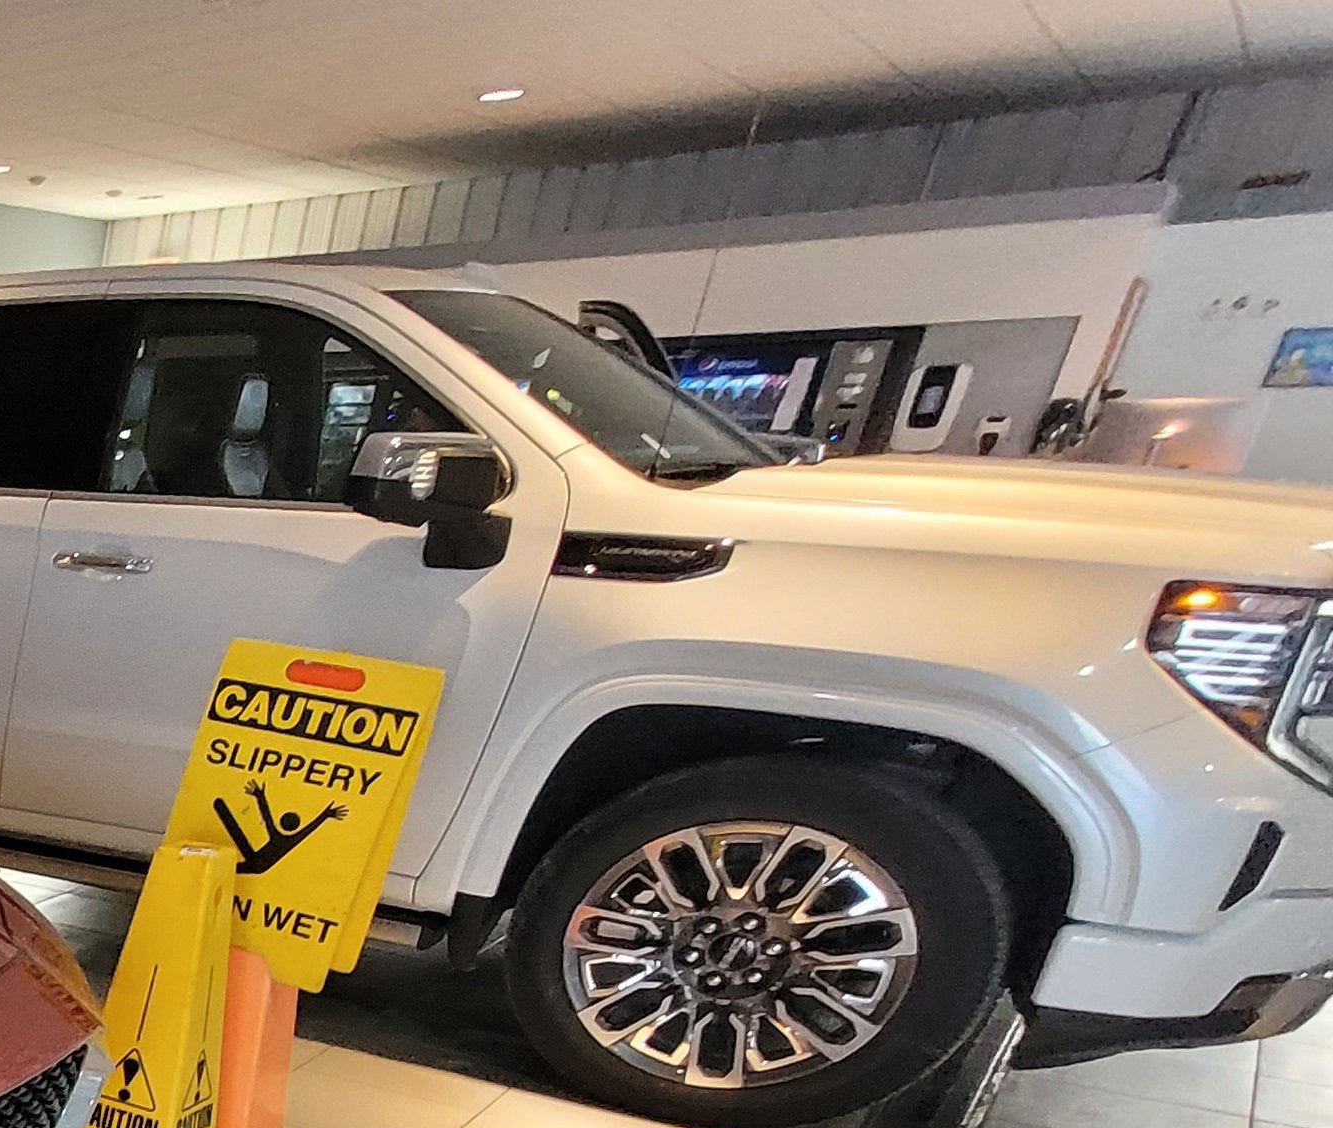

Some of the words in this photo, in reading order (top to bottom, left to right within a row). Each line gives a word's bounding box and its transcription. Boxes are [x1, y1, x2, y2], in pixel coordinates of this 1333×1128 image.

[214, 684, 414, 751] CAUTION
[206, 738, 382, 796] SLIPPERY
[263, 902, 339, 944] WET
